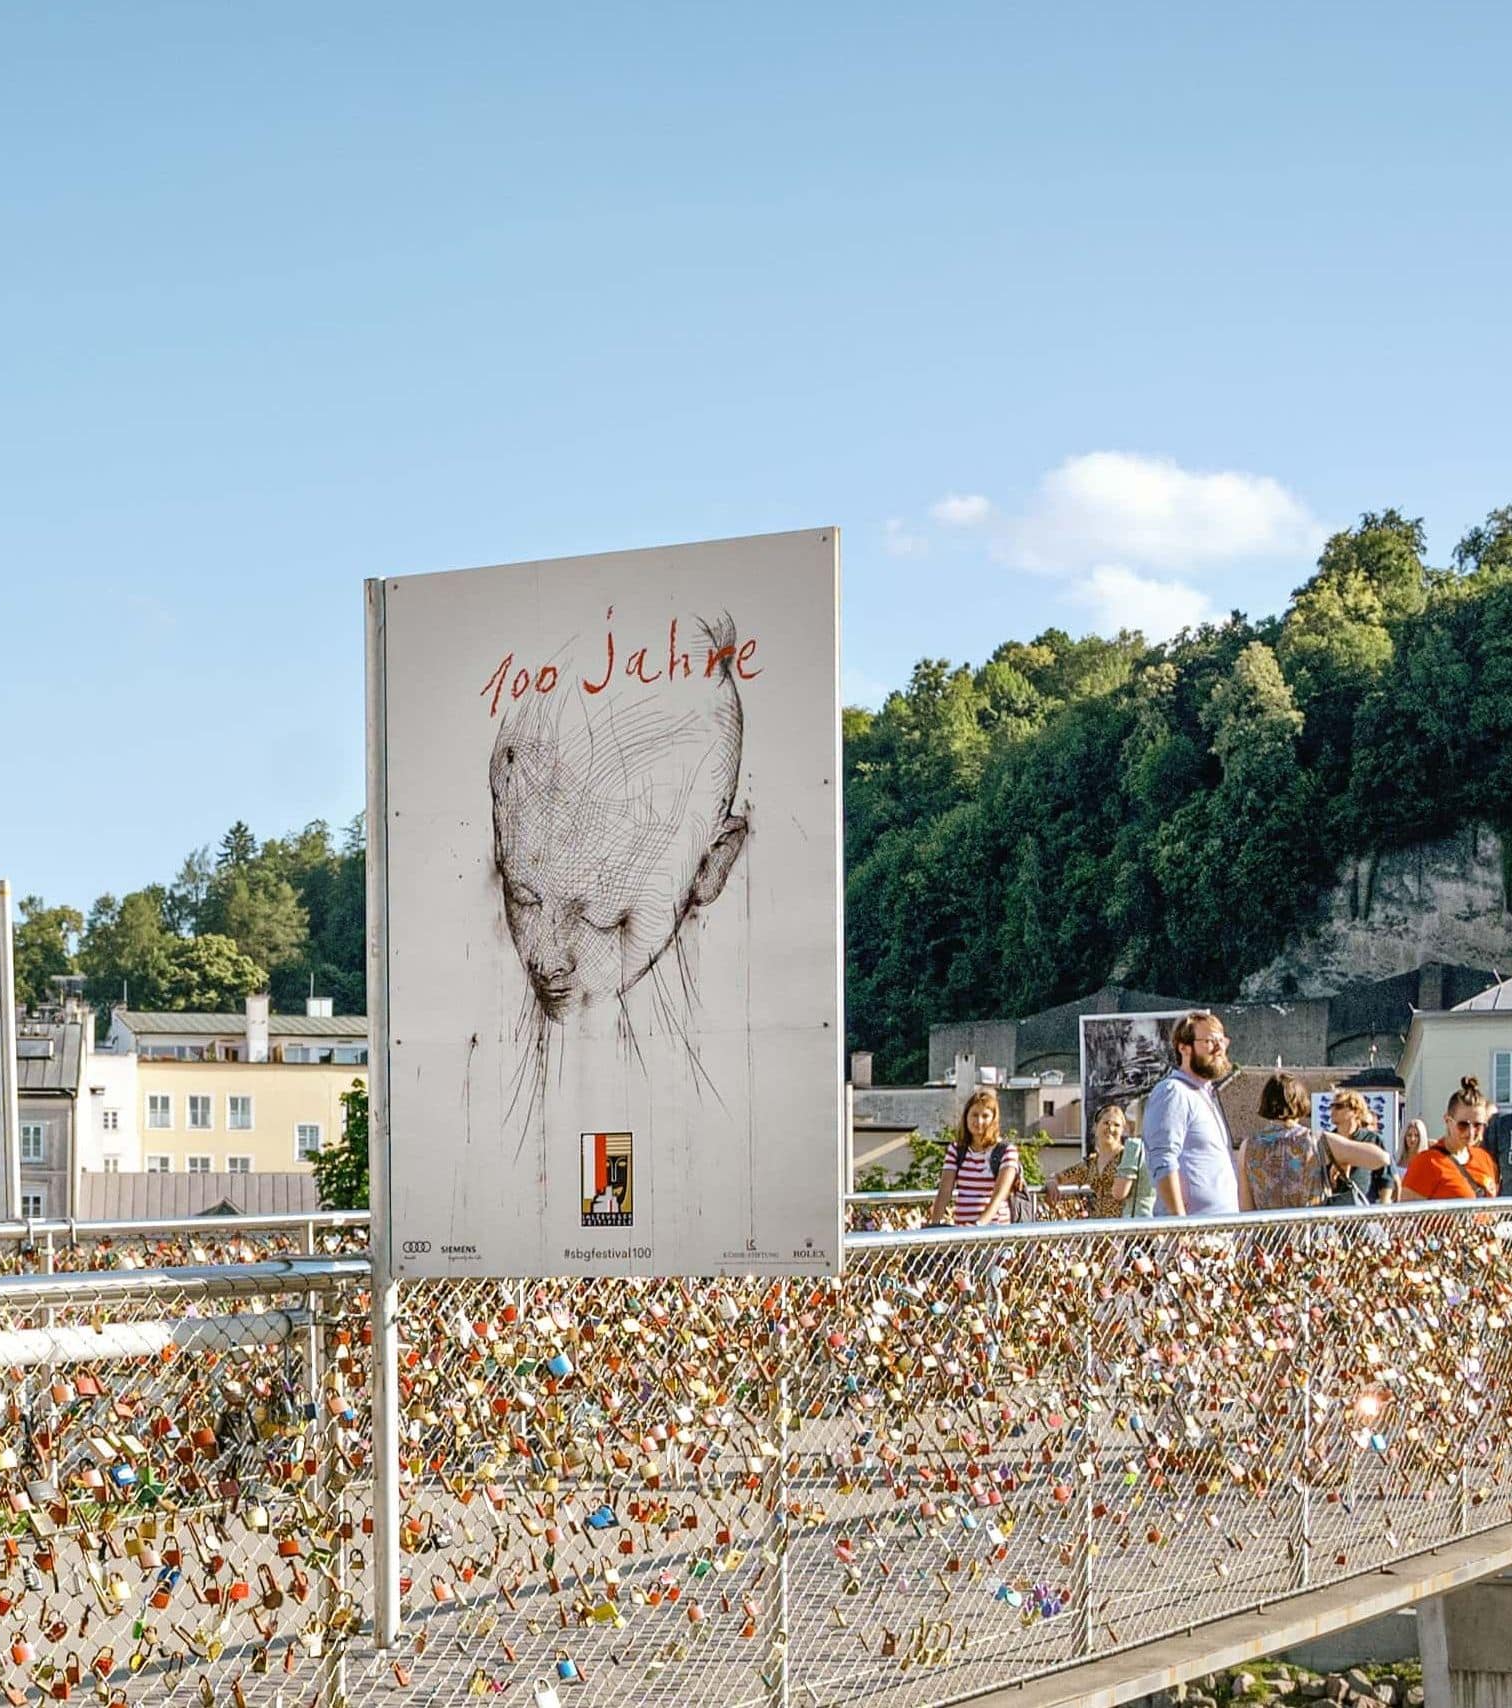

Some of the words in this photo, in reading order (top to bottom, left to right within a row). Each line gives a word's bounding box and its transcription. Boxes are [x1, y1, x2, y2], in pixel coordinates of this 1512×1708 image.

[480, 652, 558, 717] 100
[441, 1245, 476, 1254] SIEMENS
[564, 1247, 652, 1261] #sbgfestival100
[793, 1250, 825, 1258] ROLEX
